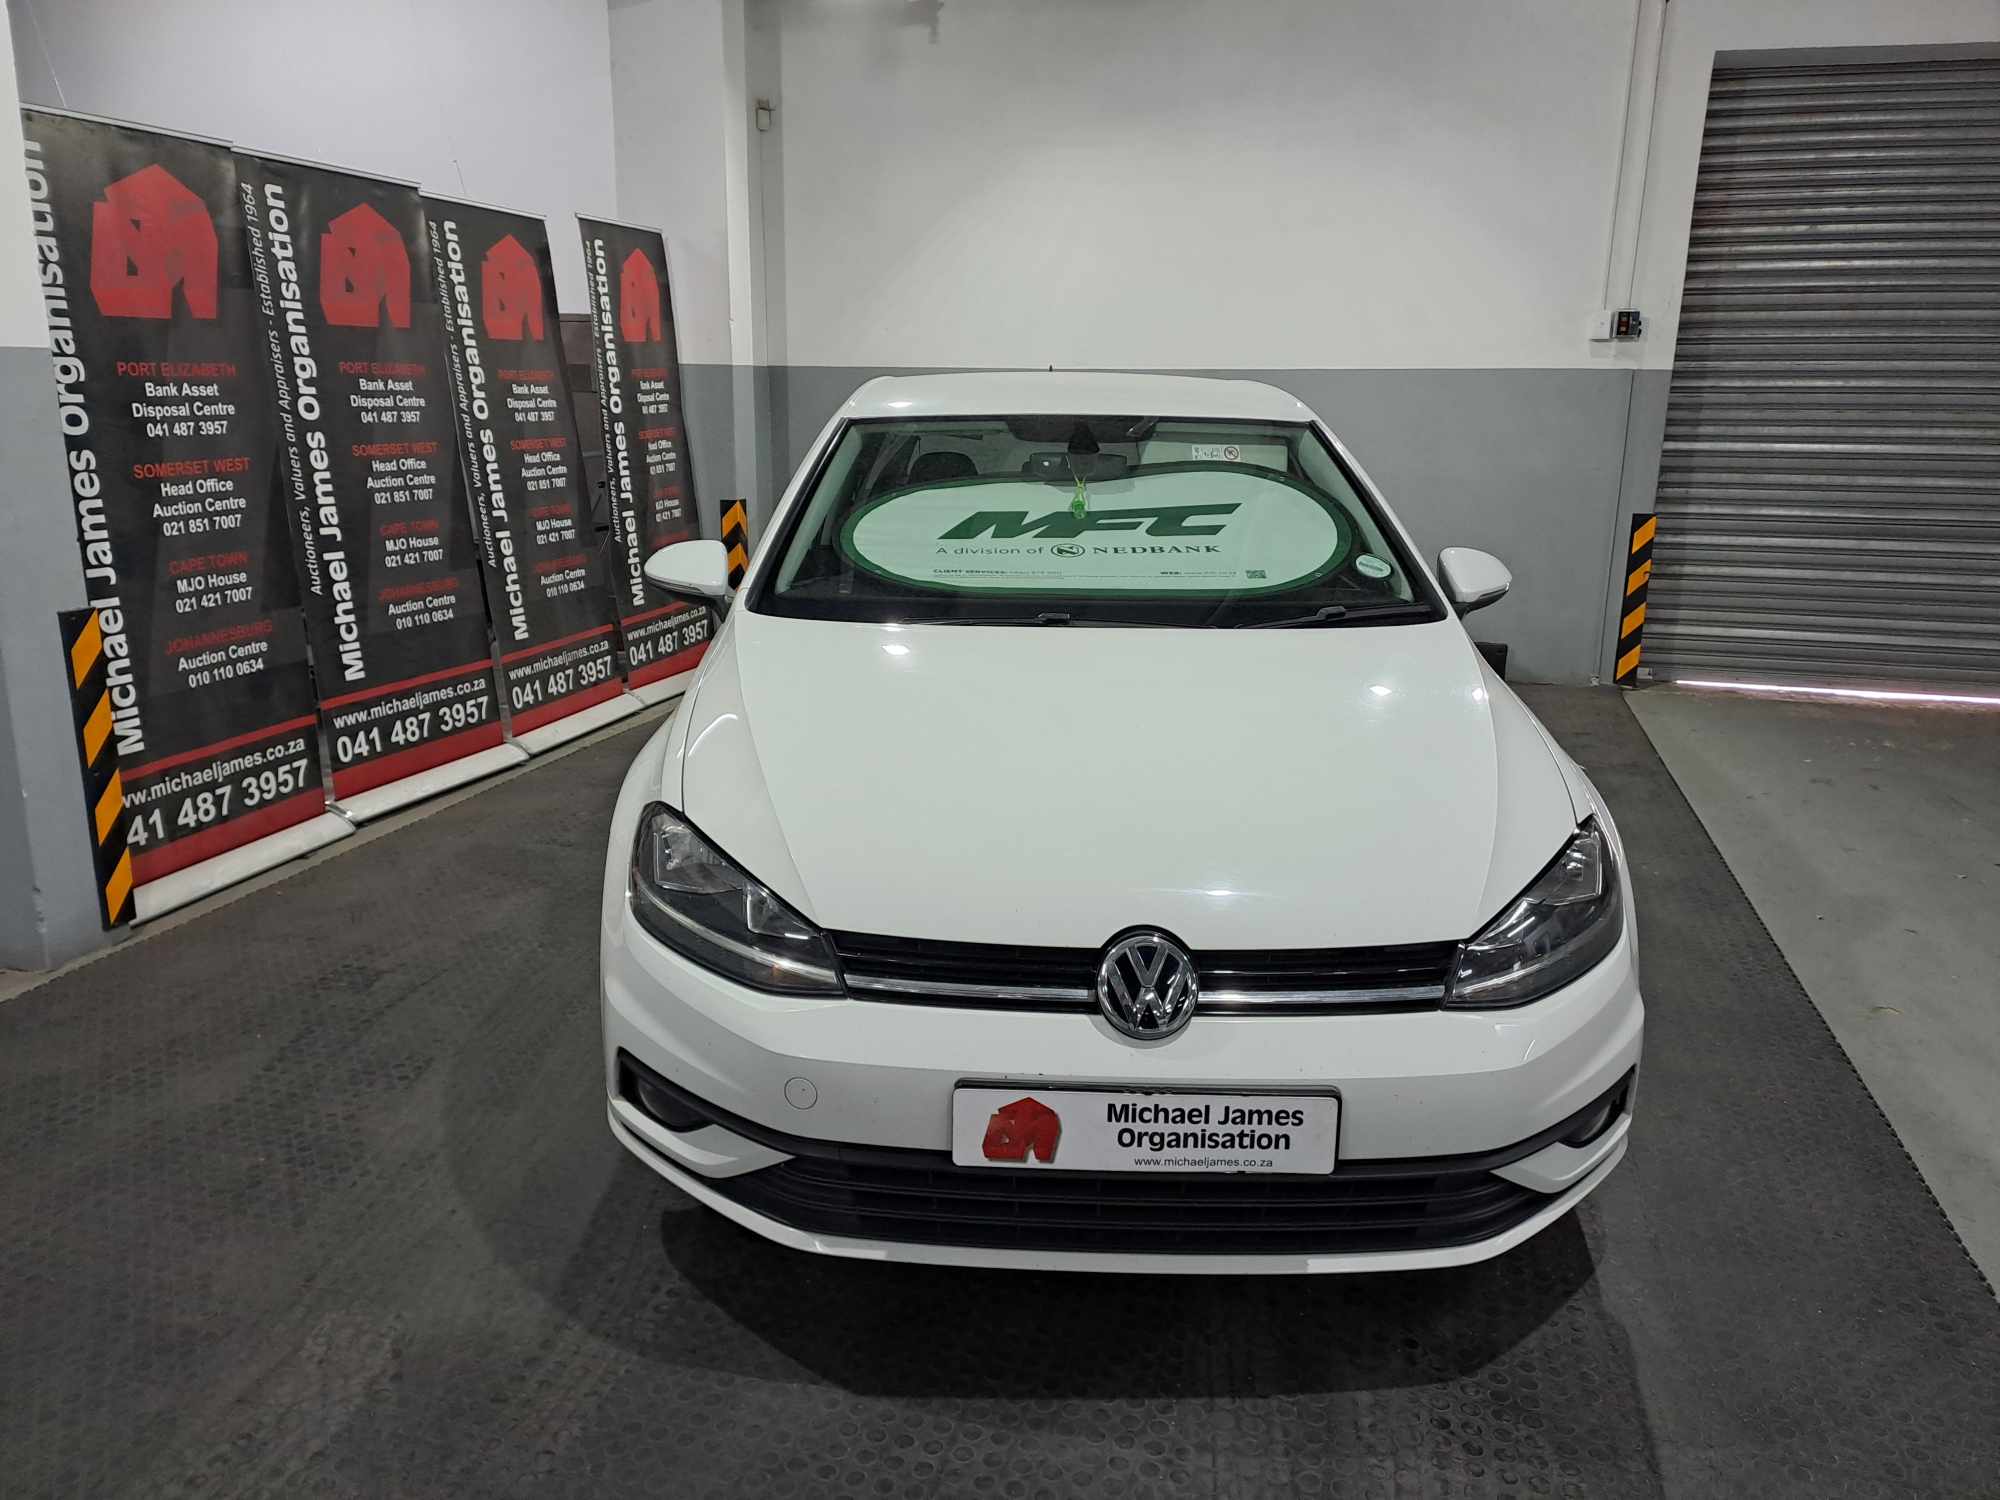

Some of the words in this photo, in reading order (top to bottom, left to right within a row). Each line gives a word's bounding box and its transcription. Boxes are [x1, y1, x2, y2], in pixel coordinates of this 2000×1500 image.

[240, 182, 260, 223] 1964
[248, 225, 274, 317] Established
[264, 183, 320, 421] Organisation
[434, 256, 455, 332] Established
[443, 220, 489, 420] Organisation
[593, 239, 622, 414] Organisation
[116, 361, 156, 377] PORT
[268, 329, 291, 410] Appraisers
[450, 343, 468, 411] Appraisers
[145, 382, 179, 397] Bank
[181, 382, 219, 397] Asset
[359, 379, 385, 391] Bank
[387, 379, 414, 391] Asset
[131, 402, 190, 420] Disposal
[193, 401, 235, 416] Centre
[350, 394, 394, 409] Disposal
[396, 395, 426, 407] Centre
[361, 412, 378, 423] 041
[381, 411, 397, 423] 487
[401, 411, 420, 422] 3957
[146, 423, 169, 437] 041
[173, 422, 194, 436] 487
[199, 421, 228, 435] 3957
[279, 412, 297, 442] and
[459, 412, 473, 439] and
[133, 460, 208, 479] SOMERSET
[213, 456, 250, 473] WEST
[289, 444, 306, 501] Valuers
[372, 459, 397, 472] Head
[399, 458, 427, 470] Office
[466, 441, 482, 488] Valuers
[479, 428, 508, 523] James
[614, 421, 632, 503] James
[160, 480, 193, 497] Head
[196, 478, 234, 494] Office
[306, 430, 342, 541] James
[367, 475, 404, 488] Auction
[406, 474, 436, 485] Centre
[374, 492, 391, 504] 021
[394, 490, 410, 502] 851
[413, 488, 433, 500] 7007
[69, 449, 117, 585] James
[152, 500, 202, 518] Auction
[205, 496, 246, 513] Centre
[937, 503, 1243, 539] MFC
[163, 521, 185, 537] 021
[189, 518, 210, 533] 851
[213, 514, 242, 530] 7007
[477, 492, 497, 568] Auctioneers,
[300, 506, 323, 597] Auctioneers,
[385, 539, 407, 551] MJO
[409, 537, 439, 548] House
[385, 555, 401, 567] 021
[404, 552, 420, 564] 421
[422, 549, 443, 562] 7007
[622, 510, 645, 607] Michael
[936, 547, 948, 555] A
[954, 546, 1020, 555] division
[1026, 546, 1044, 555] of
[1093, 545, 1221, 555] NEDBANK
[176, 576, 205, 593] MJO
[207, 571, 248, 589] House
[495, 530, 529, 641] Michael
[175, 597, 197, 613] 021
[200, 591, 222, 608] 421
[225, 586, 253, 603] 7007
[388, 600, 424, 615] Auction
[426, 595, 456, 608] Centre
[322, 550, 366, 682] Michael
[396, 616, 412, 630] 010
[414, 613, 430, 625] 110
[432, 608, 454, 622] 0634
[178, 650, 226, 671] Auction
[228, 641, 268, 659] Centre
[629, 640, 653, 666] 041
[657, 631, 679, 655] 487
[682, 619, 708, 645] 3957
[188, 670, 210, 688] 010
[212, 664, 234, 682] 110
[236, 657, 264, 676] 0634
[508, 640, 609, 680] www.michaeljames.co.za
[90, 596, 145, 757] Michael
[512, 680, 543, 709] 041
[547, 669, 574, 696] 487
[578, 655, 611, 685] 3957
[333, 678, 486, 729] www.michaeljames.co.za
[336, 726, 382, 763] 041
[390, 712, 431, 746] 487
[438, 695, 489, 732] 3957
[127, 808, 165, 847] 41
[177, 785, 232, 828] 487
[242, 758, 308, 807] 3957
[1106, 1103, 1210, 1125] Michael
[1218, 1105, 1305, 1126] James
[1116, 1127, 1291, 1151] Organisation
[1134, 1156, 1273, 1168] www.michaeljames.co.za
